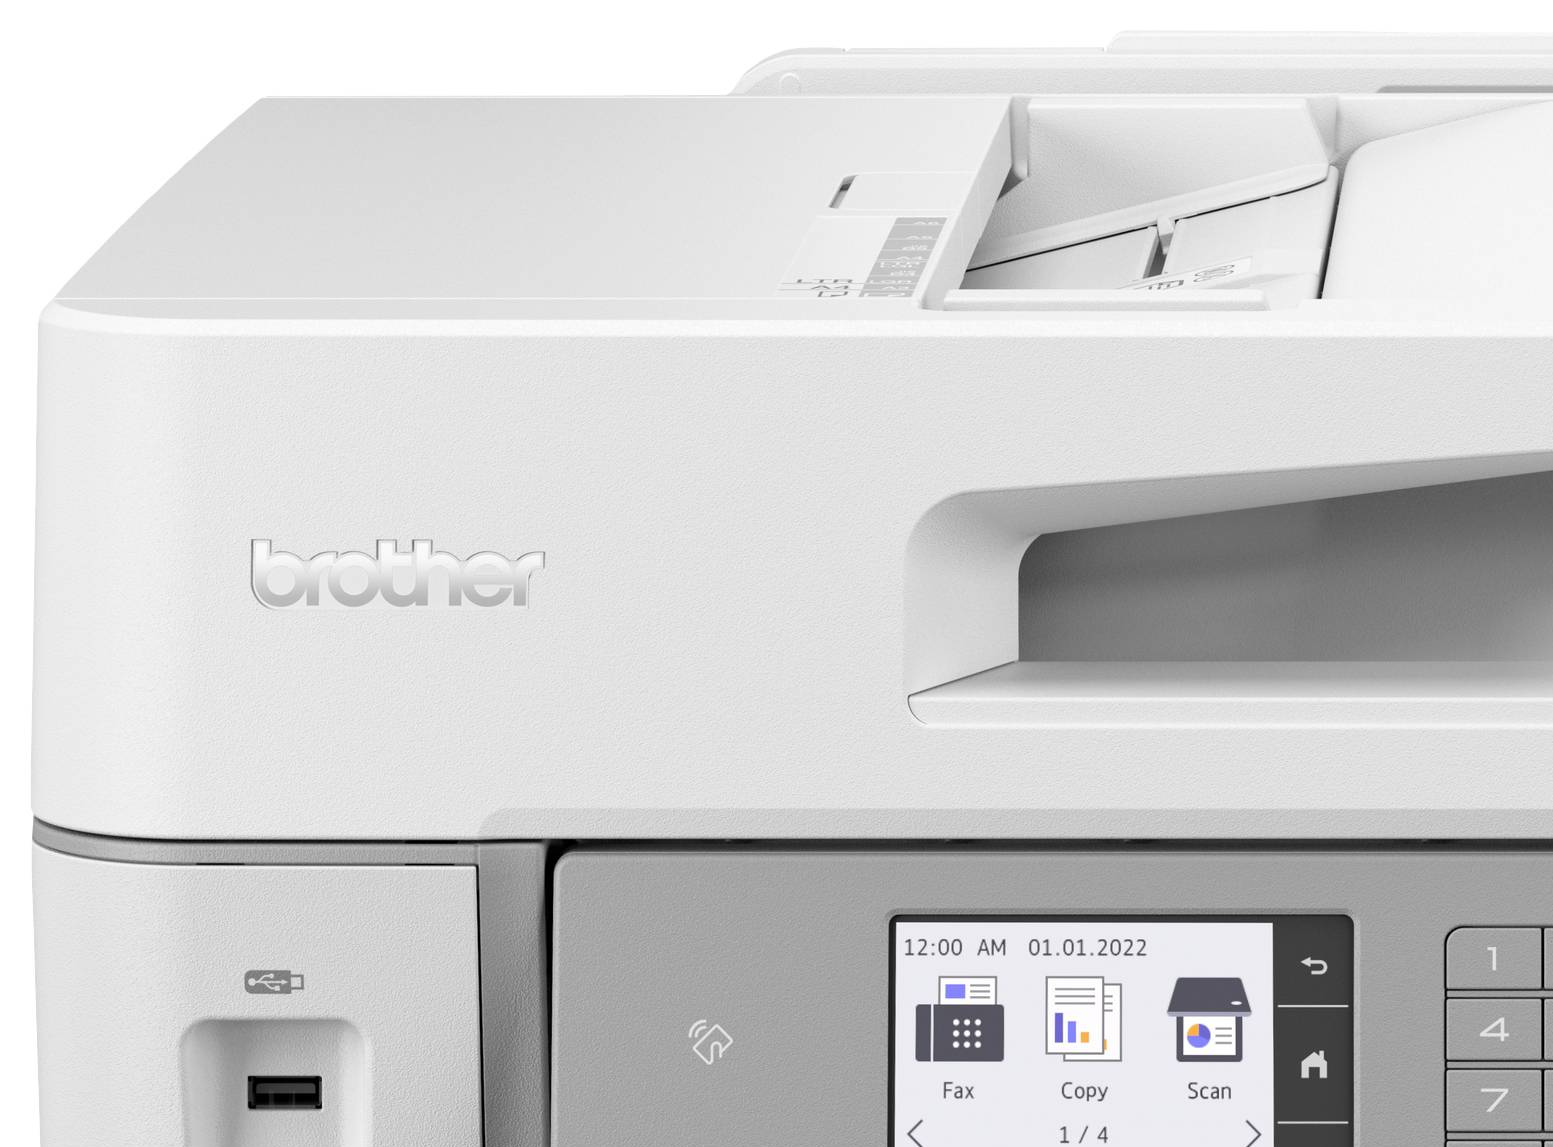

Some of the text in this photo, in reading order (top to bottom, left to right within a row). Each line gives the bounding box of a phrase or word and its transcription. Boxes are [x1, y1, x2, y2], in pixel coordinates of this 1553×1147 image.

[251, 539, 546, 608] brother
[904, 938, 1147, 957] 12:00 AM 01.01.2022
[1487, 946, 1498, 972] 1
[1479, 1017, 1510, 1042] 4
[943, 1081, 975, 1100] Fax
[1060, 1081, 1109, 1104] Copy
[1187, 1081, 1232, 1100] Scan
[1480, 1088, 1509, 1113] 7
[1059, 1125, 1109, 1145] 1 / 4
